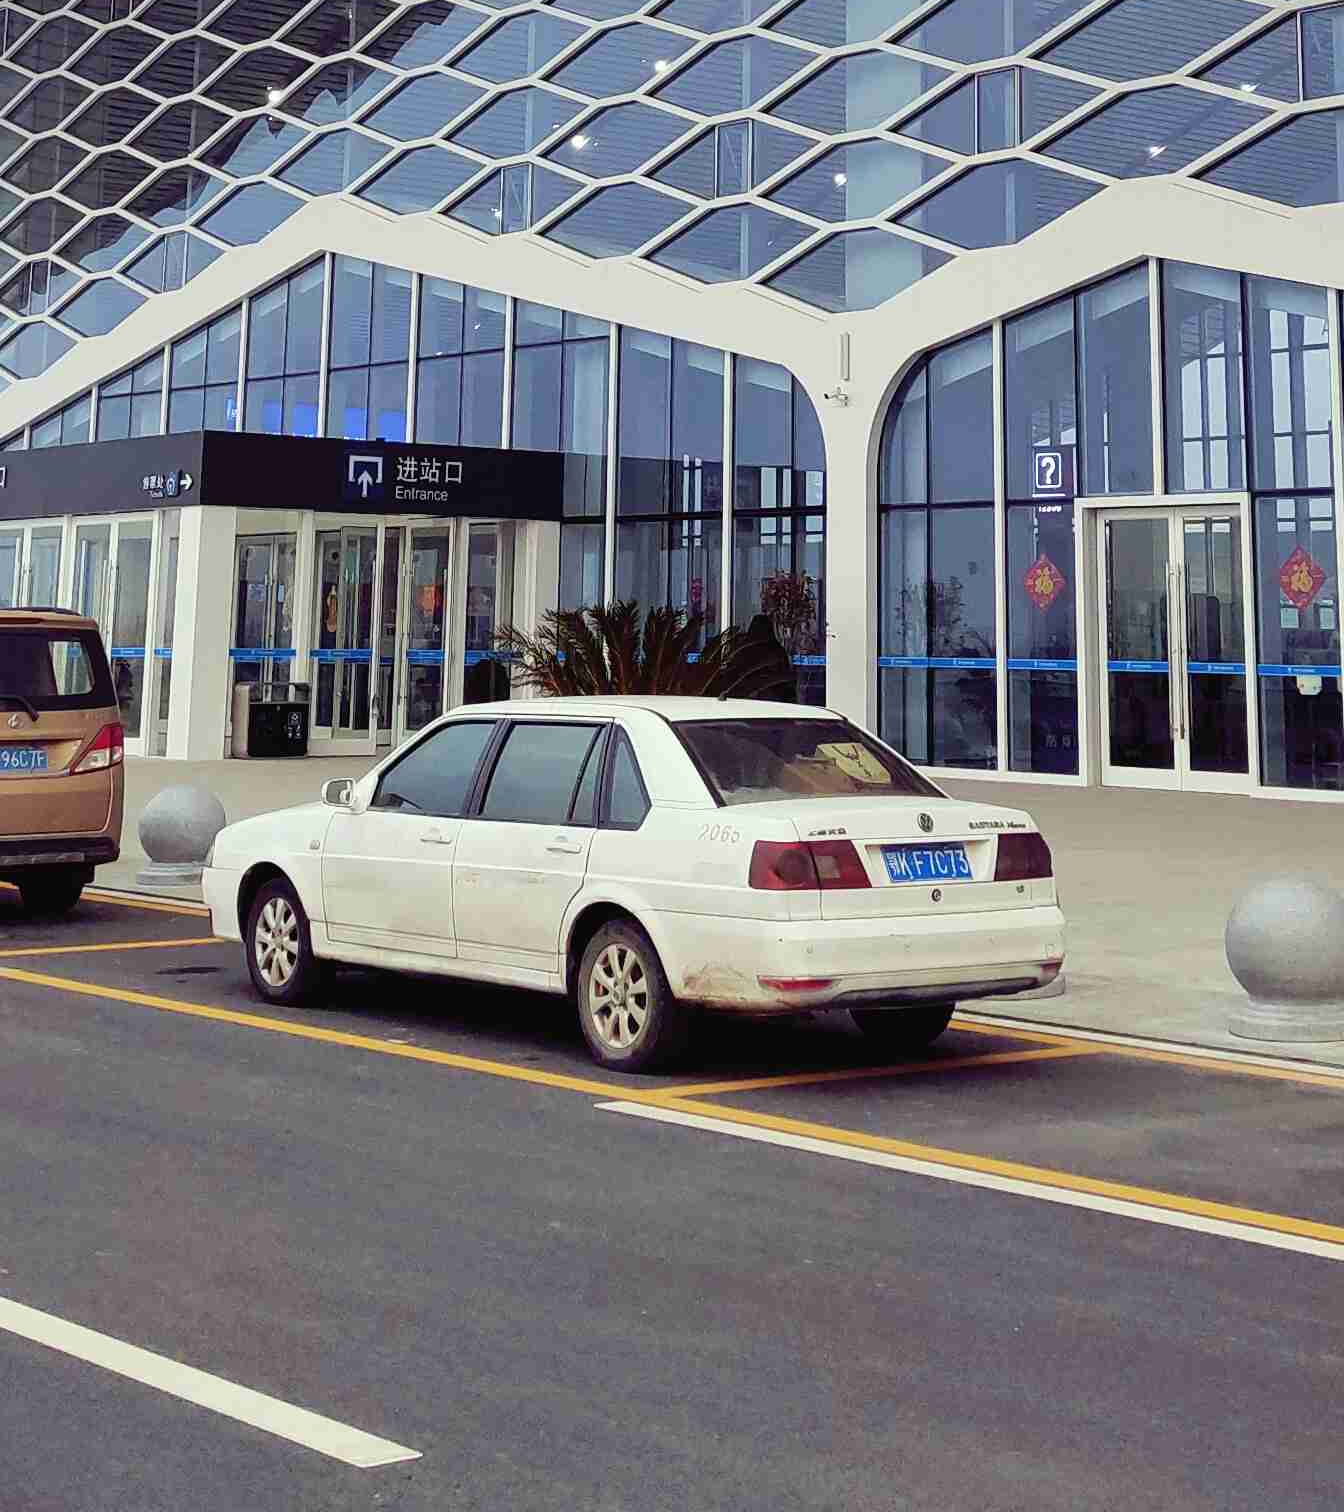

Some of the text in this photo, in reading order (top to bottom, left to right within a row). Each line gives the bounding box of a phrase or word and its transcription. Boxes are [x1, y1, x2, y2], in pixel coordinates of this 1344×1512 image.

[396, 456, 463, 484] 进站口
[395, 486, 449, 502] Entrance
